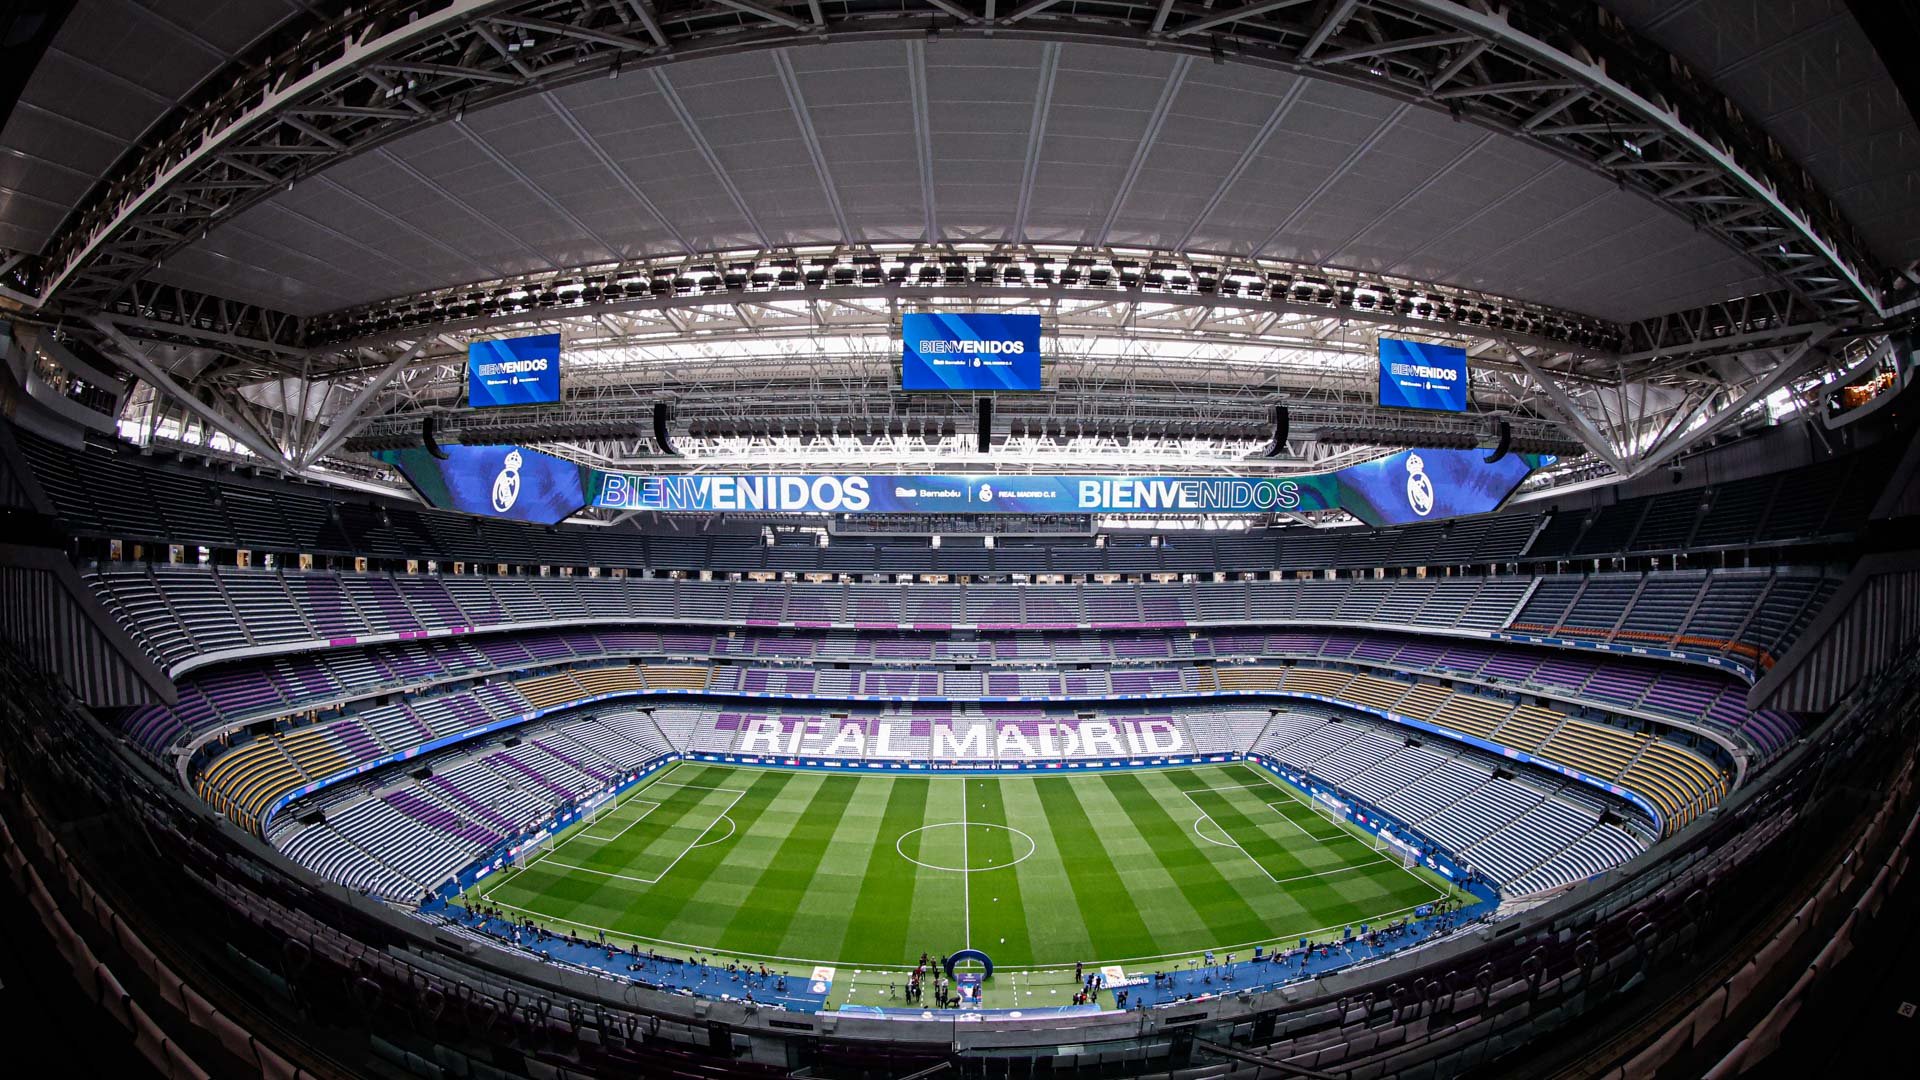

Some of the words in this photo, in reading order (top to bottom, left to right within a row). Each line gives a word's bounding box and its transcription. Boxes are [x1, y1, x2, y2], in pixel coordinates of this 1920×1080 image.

[919, 340, 1024, 354] BIENVENIDOS
[478, 359, 548, 376] BIENVENIDOS
[1391, 363, 1457, 381] BIENVENIDOS
[600, 474, 870, 510] BIENVENIDOS
[1078, 480, 1300, 509] BIENVENIDOS
[741, 719, 912, 757] REAL
[932, 719, 1184, 757] MADRID
